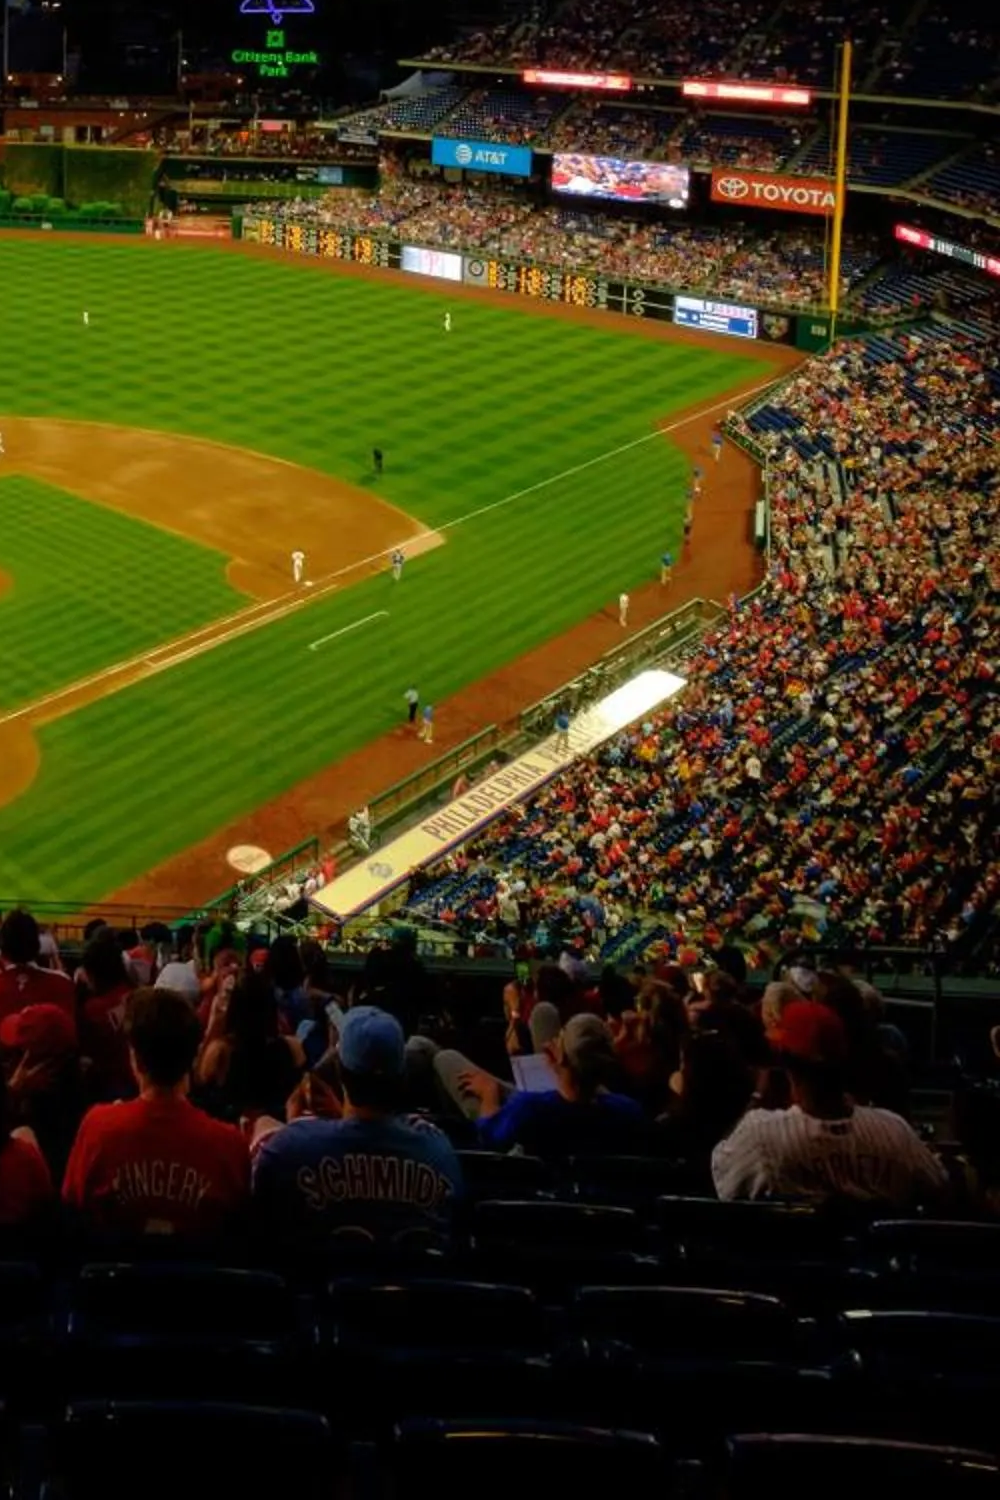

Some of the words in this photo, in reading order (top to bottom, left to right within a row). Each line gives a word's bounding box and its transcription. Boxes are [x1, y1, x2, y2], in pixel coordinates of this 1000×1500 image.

[231, 50, 283, 63] Citizens
[285, 50, 317, 63] Bank
[259, 63, 288, 77] Park
[475, 149, 508, 166] AT&T
[751, 182, 836, 208] TOYOTA
[421, 761, 548, 842] PHILADELPHIA
[296, 1153, 455, 1211] SCHMIDT
